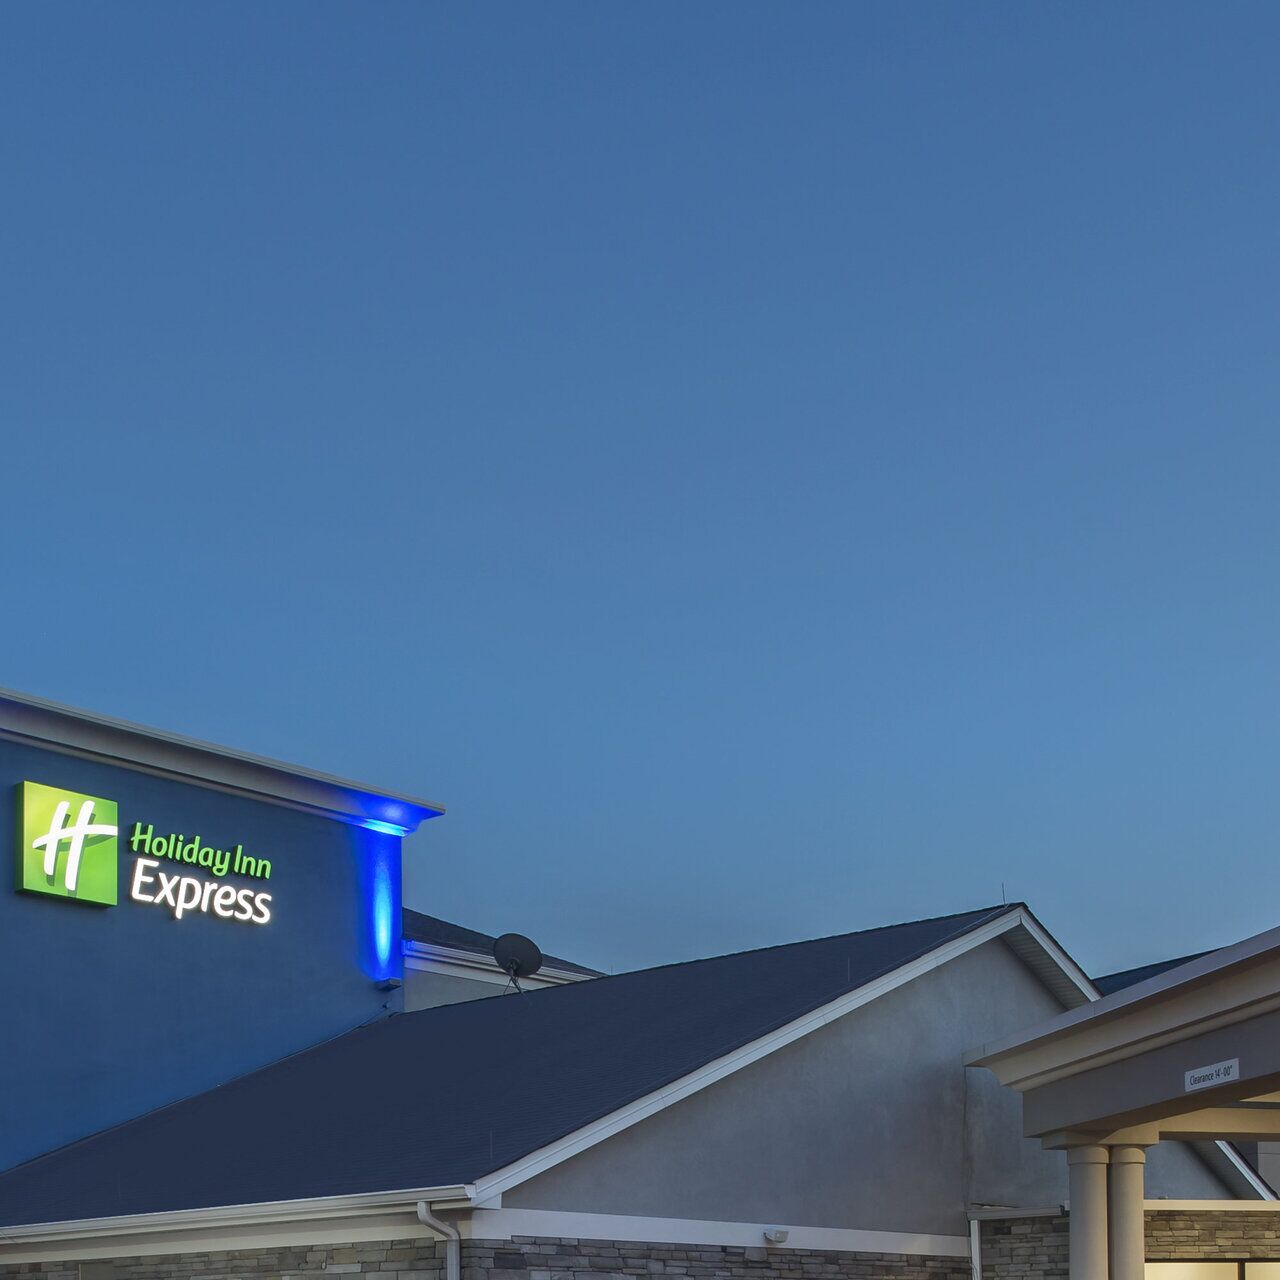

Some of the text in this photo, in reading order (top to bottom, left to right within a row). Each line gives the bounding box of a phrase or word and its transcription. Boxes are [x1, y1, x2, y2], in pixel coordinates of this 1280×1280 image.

[130, 822, 272, 880] Holiday Inn
[131, 857, 273, 924] Express
[1190, 1073, 1214, 1085] Clearance
